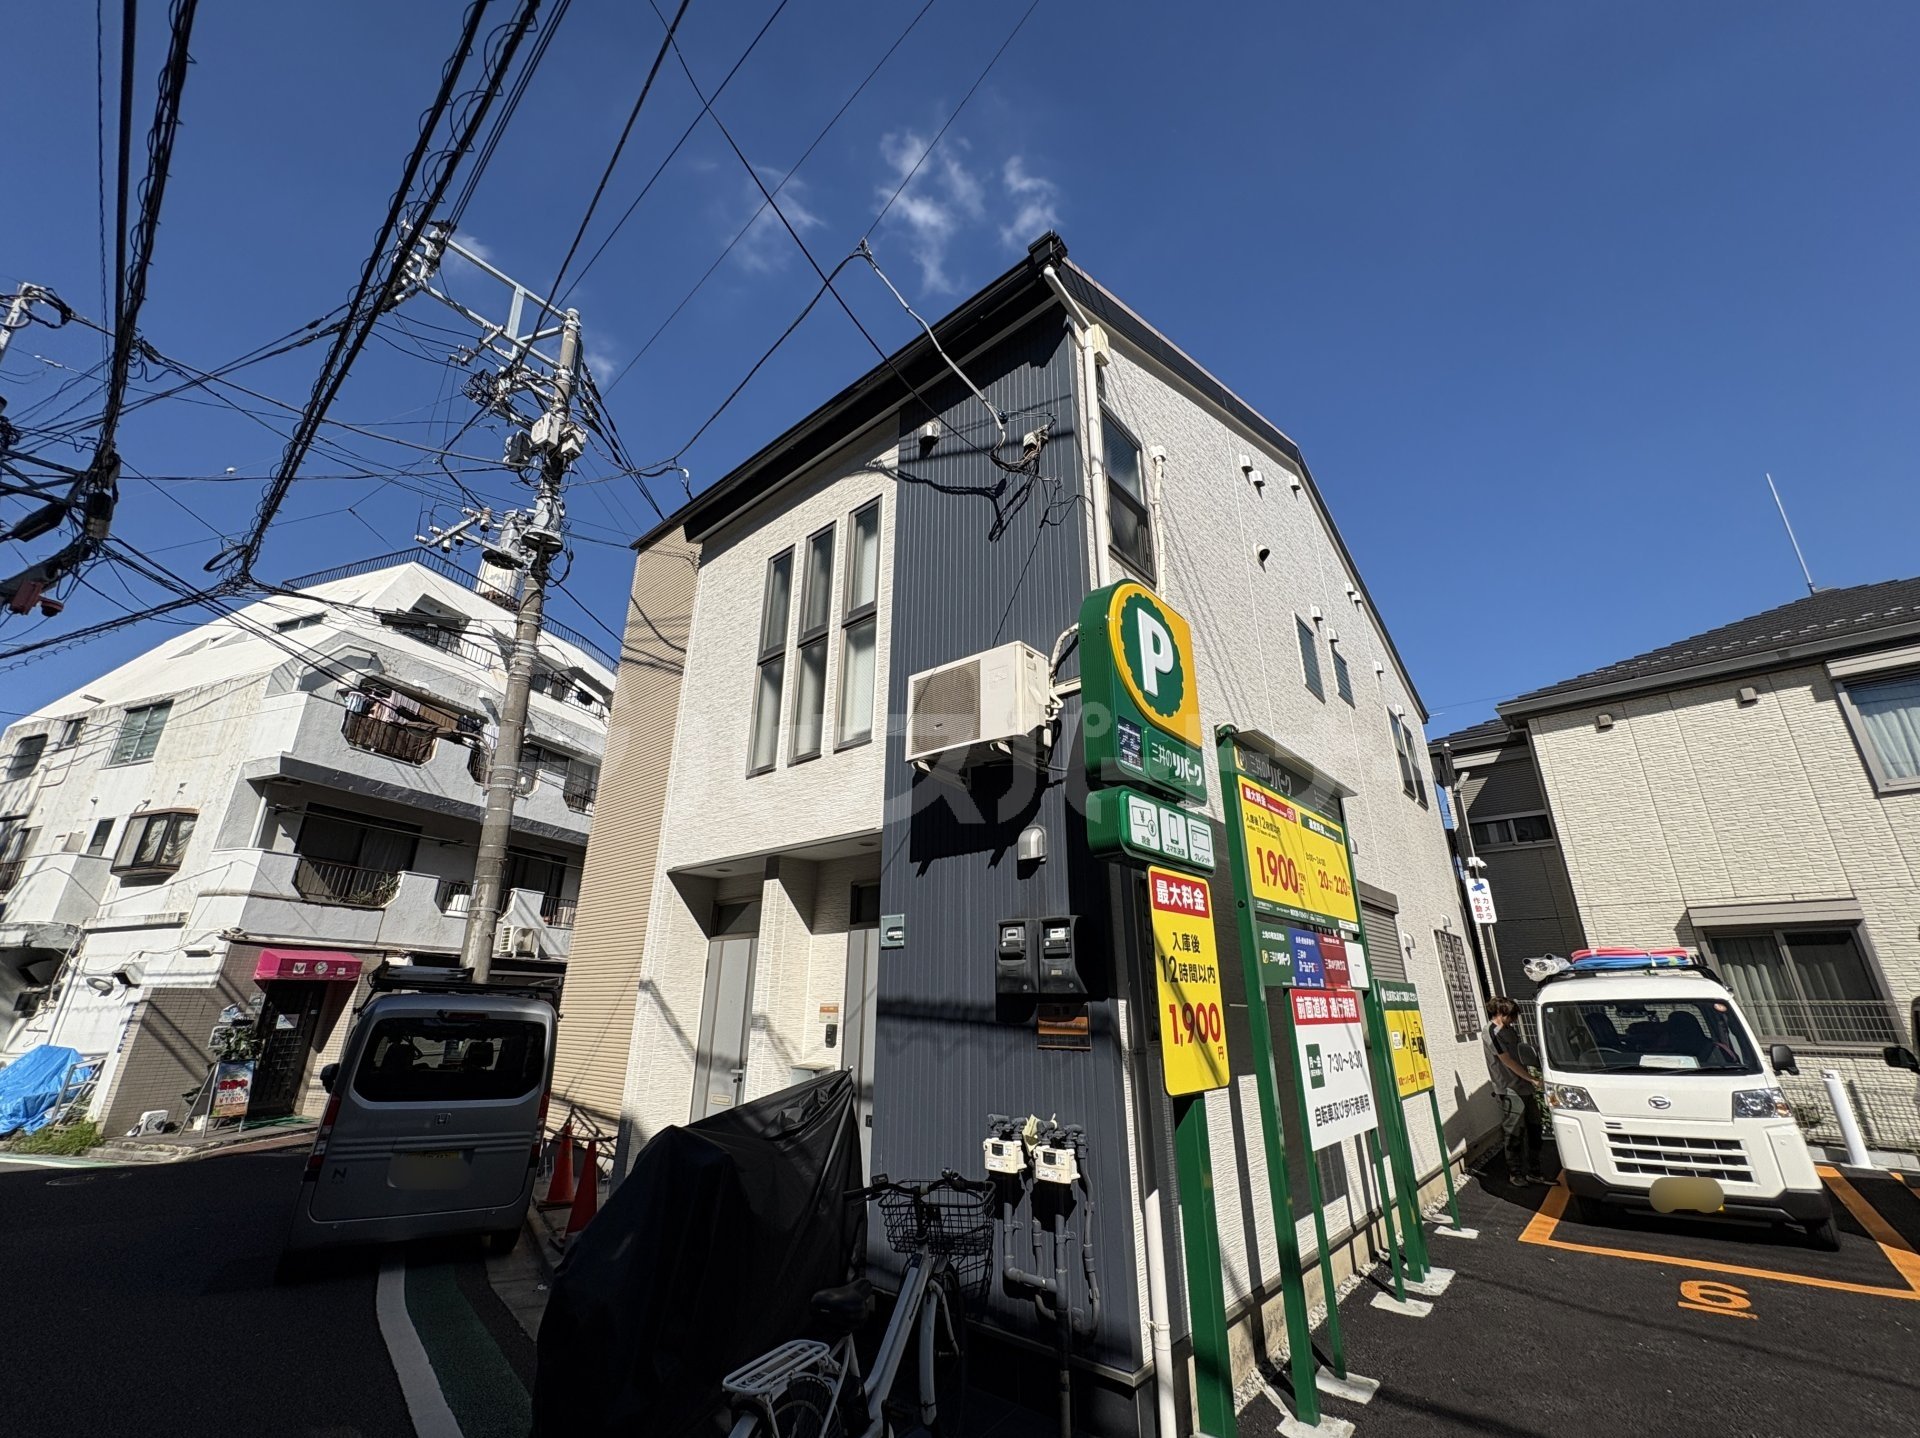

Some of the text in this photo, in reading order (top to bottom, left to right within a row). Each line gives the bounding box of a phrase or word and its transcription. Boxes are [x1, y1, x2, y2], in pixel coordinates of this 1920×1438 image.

[1137, 607, 1174, 698] P
[1151, 742, 1203, 787] 三井のリパーク
[1249, 754, 1293, 796] 三井のリパーク
[1244, 786, 1267, 807] 最大料金
[1193, 852, 1212, 865] クレジット
[1256, 846, 1299, 894] 1,900
[1156, 879, 1207, 912] 最大料金
[1473, 896, 1485, 920] 作動中
[1482, 897, 1493, 920] カメラ
[1172, 931, 1201, 954] 入庫後
[1161, 955, 1216, 986] 12時間以内
[1296, 996, 1329, 1020] 前面道路
[1329, 996, 1358, 1019] 通行規制
[1169, 1002, 1221, 1047] 1,900
[1217, 1046, 1225, 1061] 円
[1314, 1094, 1371, 1128] 自転車及び歩行者専用
[1680, 1279, 1752, 1309] 6
